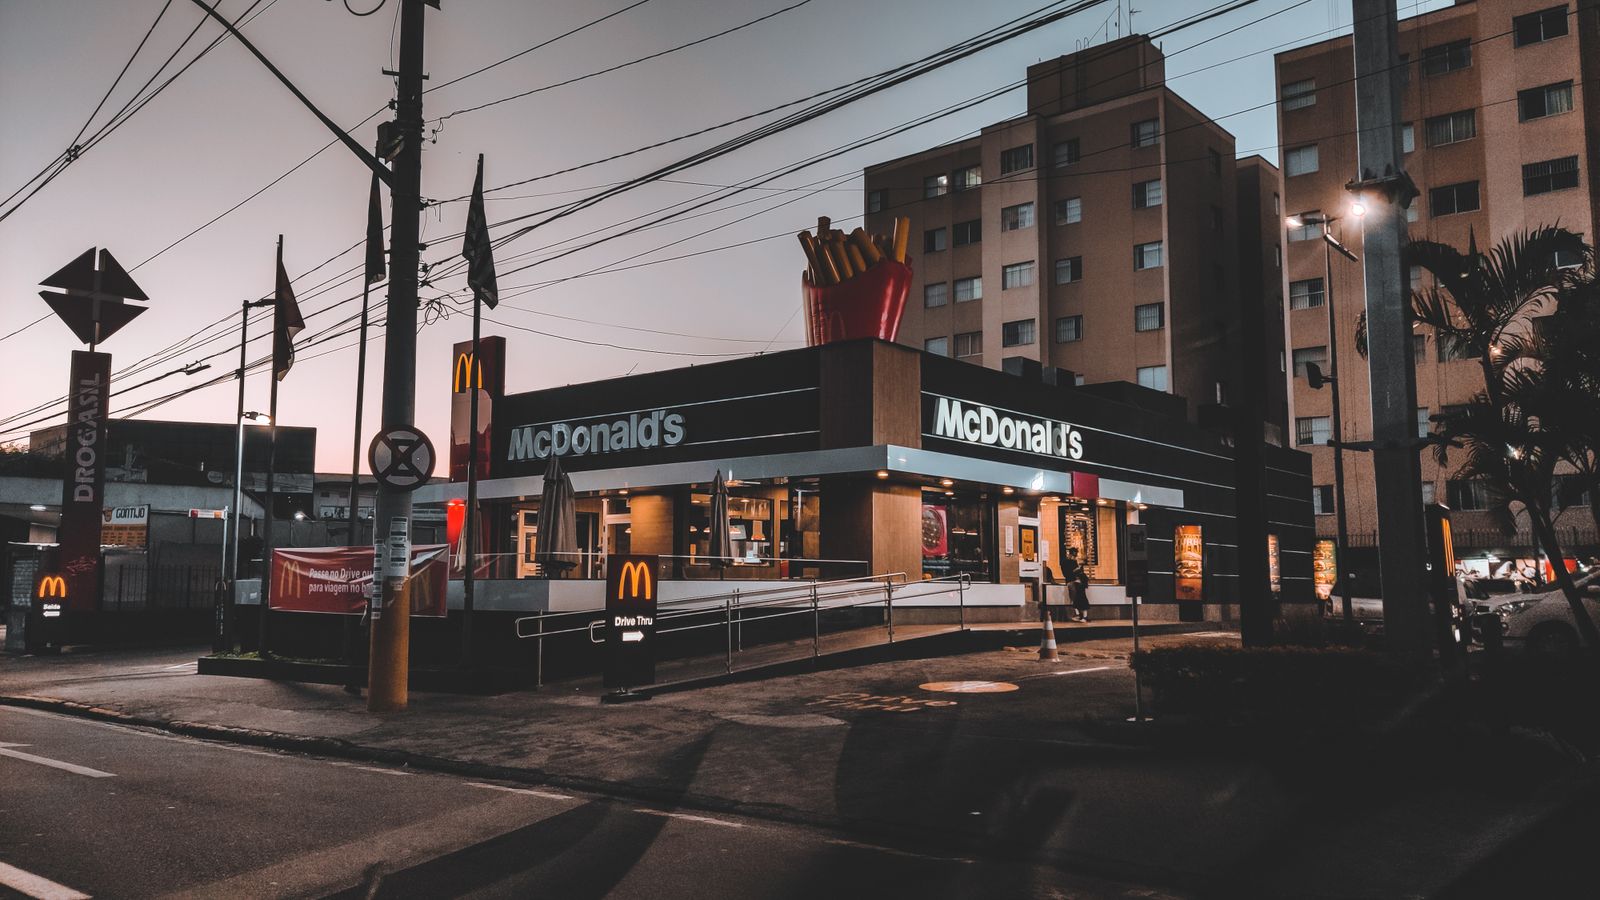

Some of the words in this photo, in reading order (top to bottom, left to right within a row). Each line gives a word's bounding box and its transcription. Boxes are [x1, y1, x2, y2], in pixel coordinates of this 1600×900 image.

[74, 373, 100, 502] DROGASIL
[508, 410, 685, 461] McDonald's
[933, 398, 1083, 460] McDonald's
[309, 568, 329, 579] Passe
[330, 571, 339, 580] no
[340, 568, 360, 580] Drive
[309, 584, 323, 595] para
[324, 582, 348, 596] viagem
[350, 583, 359, 593] no
[615, 616, 635, 626] Drive
[637, 615, 653, 625] Thru
